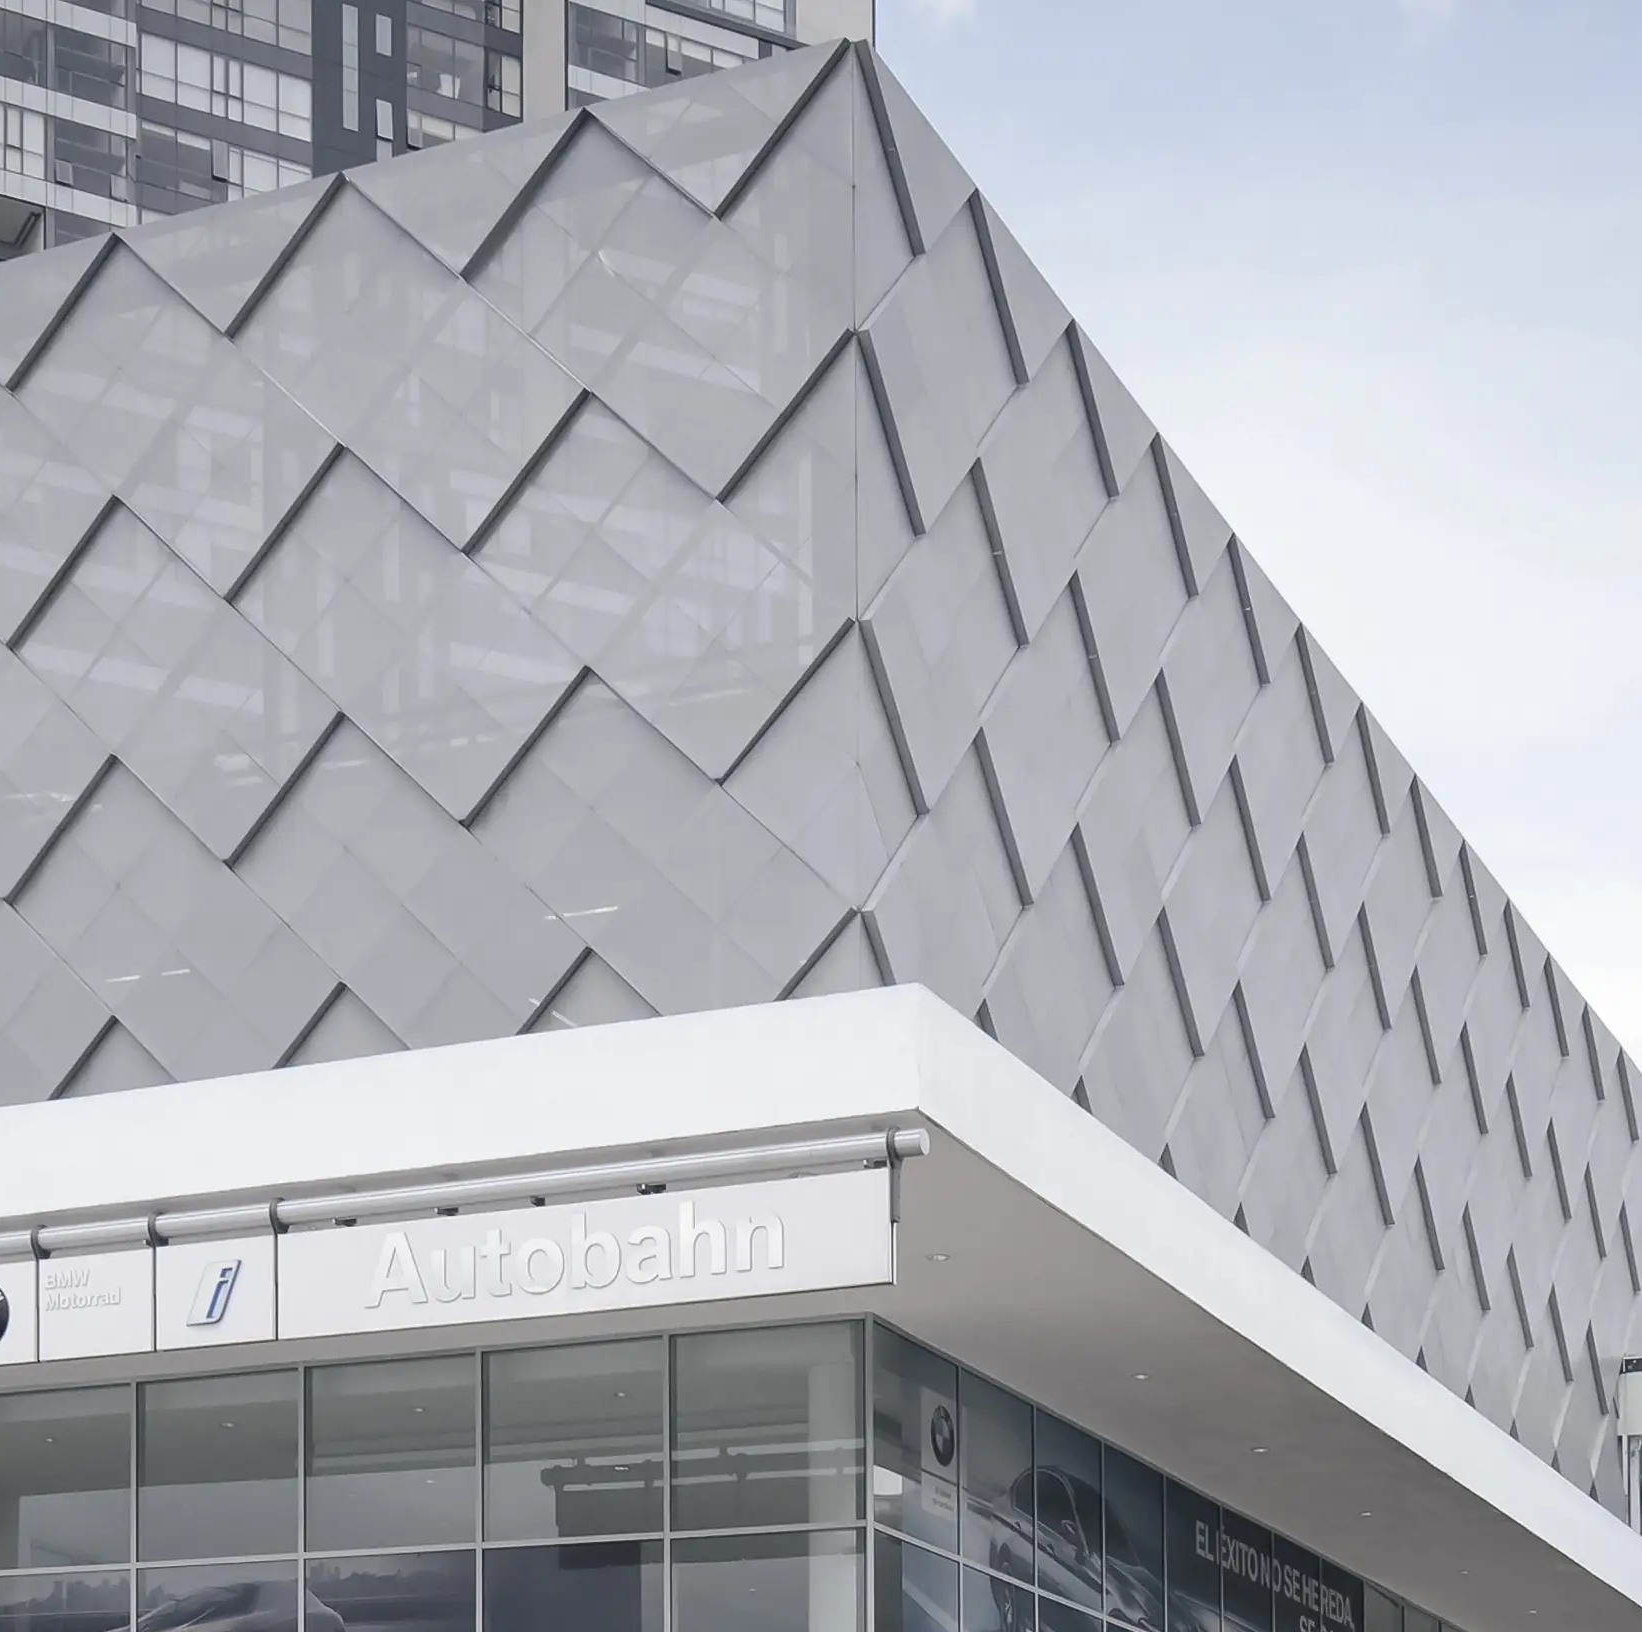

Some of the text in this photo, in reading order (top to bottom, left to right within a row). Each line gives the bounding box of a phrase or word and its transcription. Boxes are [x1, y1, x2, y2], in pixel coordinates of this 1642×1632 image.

[44, 1269, 90, 1290] BMW
[364, 1199, 785, 1309] Autobahn
[45, 1287, 121, 1312] Motorrad
[1195, 1520, 1214, 1562] EL
[1215, 1524, 1258, 1582] ÉXITO
[1260, 1553, 1282, 1593] NO
[1283, 1564, 1301, 1603] SE
